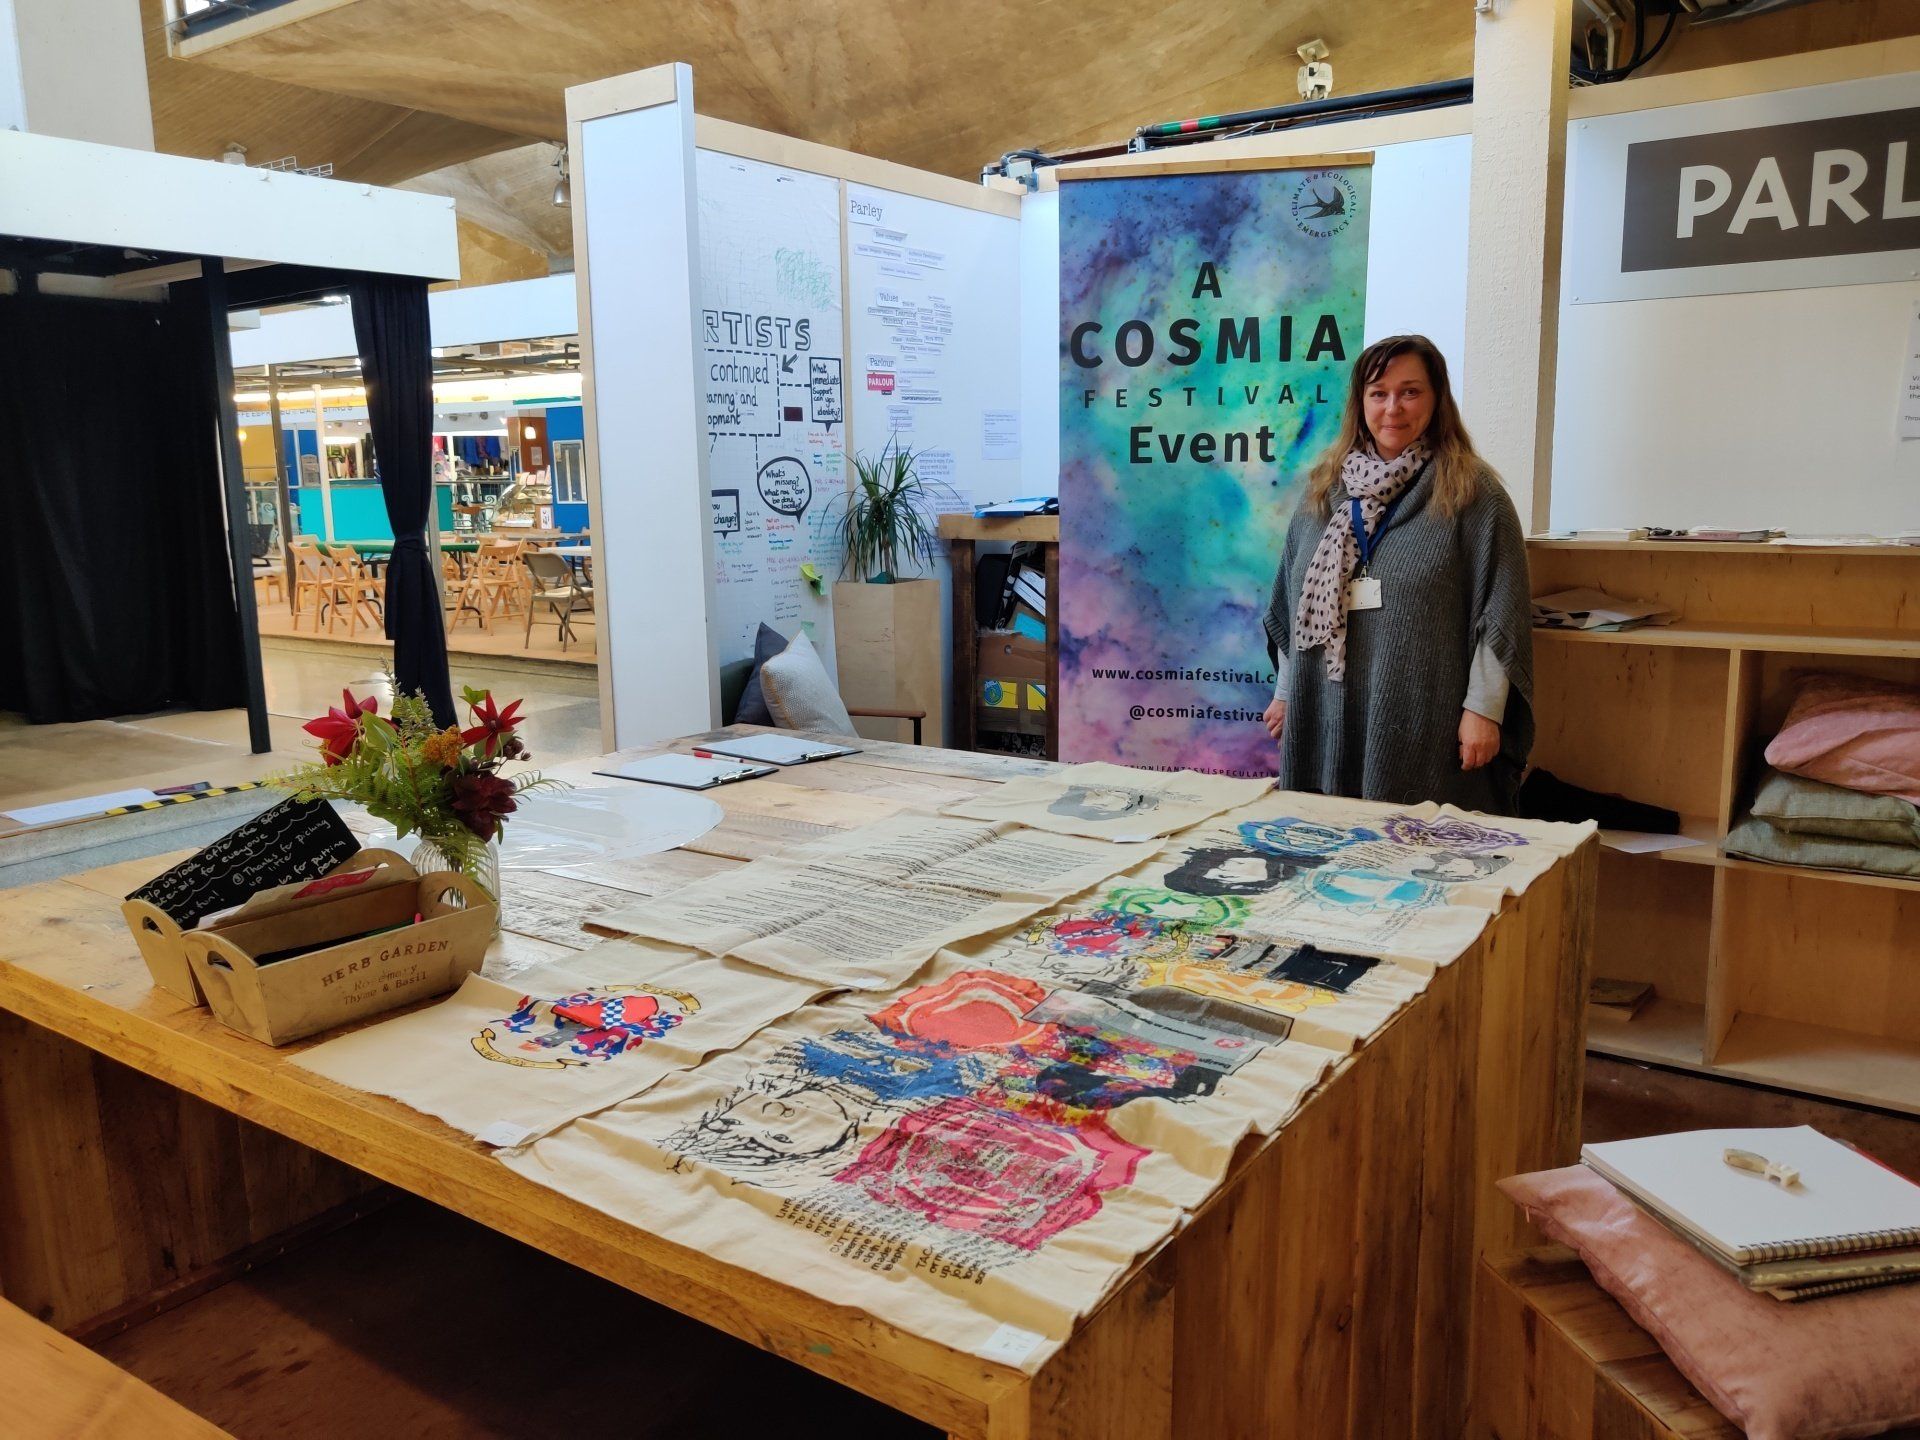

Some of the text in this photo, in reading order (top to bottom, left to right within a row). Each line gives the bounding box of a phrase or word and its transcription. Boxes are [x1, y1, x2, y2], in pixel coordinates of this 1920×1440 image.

[1291, 176, 1312, 217] CLIMATE
[1321, 171, 1357, 212] ECOLOGICAL
[1676, 140, 1920, 239] PARL
[850, 200, 883, 221] Parley
[1297, 219, 1350, 238] EMERGENCY
[1191, 261, 1223, 299] A
[702, 309, 812, 351] RTISTS
[1070, 314, 1346, 369] COSMIA
[711, 356, 769, 384] continued
[869, 357, 895, 368] Parlour
[868, 377, 894, 386] PARLOUR
[741, 385, 758, 407] and
[1083, 384, 1328, 409] FESTIVAL
[707, 408, 741, 429] opment
[1129, 425, 1276, 464] Event
[713, 512, 737, 528] change?
[1092, 667, 1278, 684] www.cosmiafestival.c
[1129, 705, 1264, 722] @cosmiafestiva
[242, 853, 278, 876] Thanks
[280, 841, 293, 853] for
[295, 819, 331, 845] picking
[155, 833, 268, 906] aterials for everyone
[162, 877, 177, 888] us
[177, 863, 201, 878] look
[205, 840, 232, 860] after
[248, 876, 263, 887] up
[268, 853, 292, 872] litter
[293, 861, 307, 875] for
[176, 890, 225, 924] ave fun!
[320, 940, 449, 987] HERB GARDEN
[382, 984, 389, 992] &
[395, 971, 427, 989] Basil
